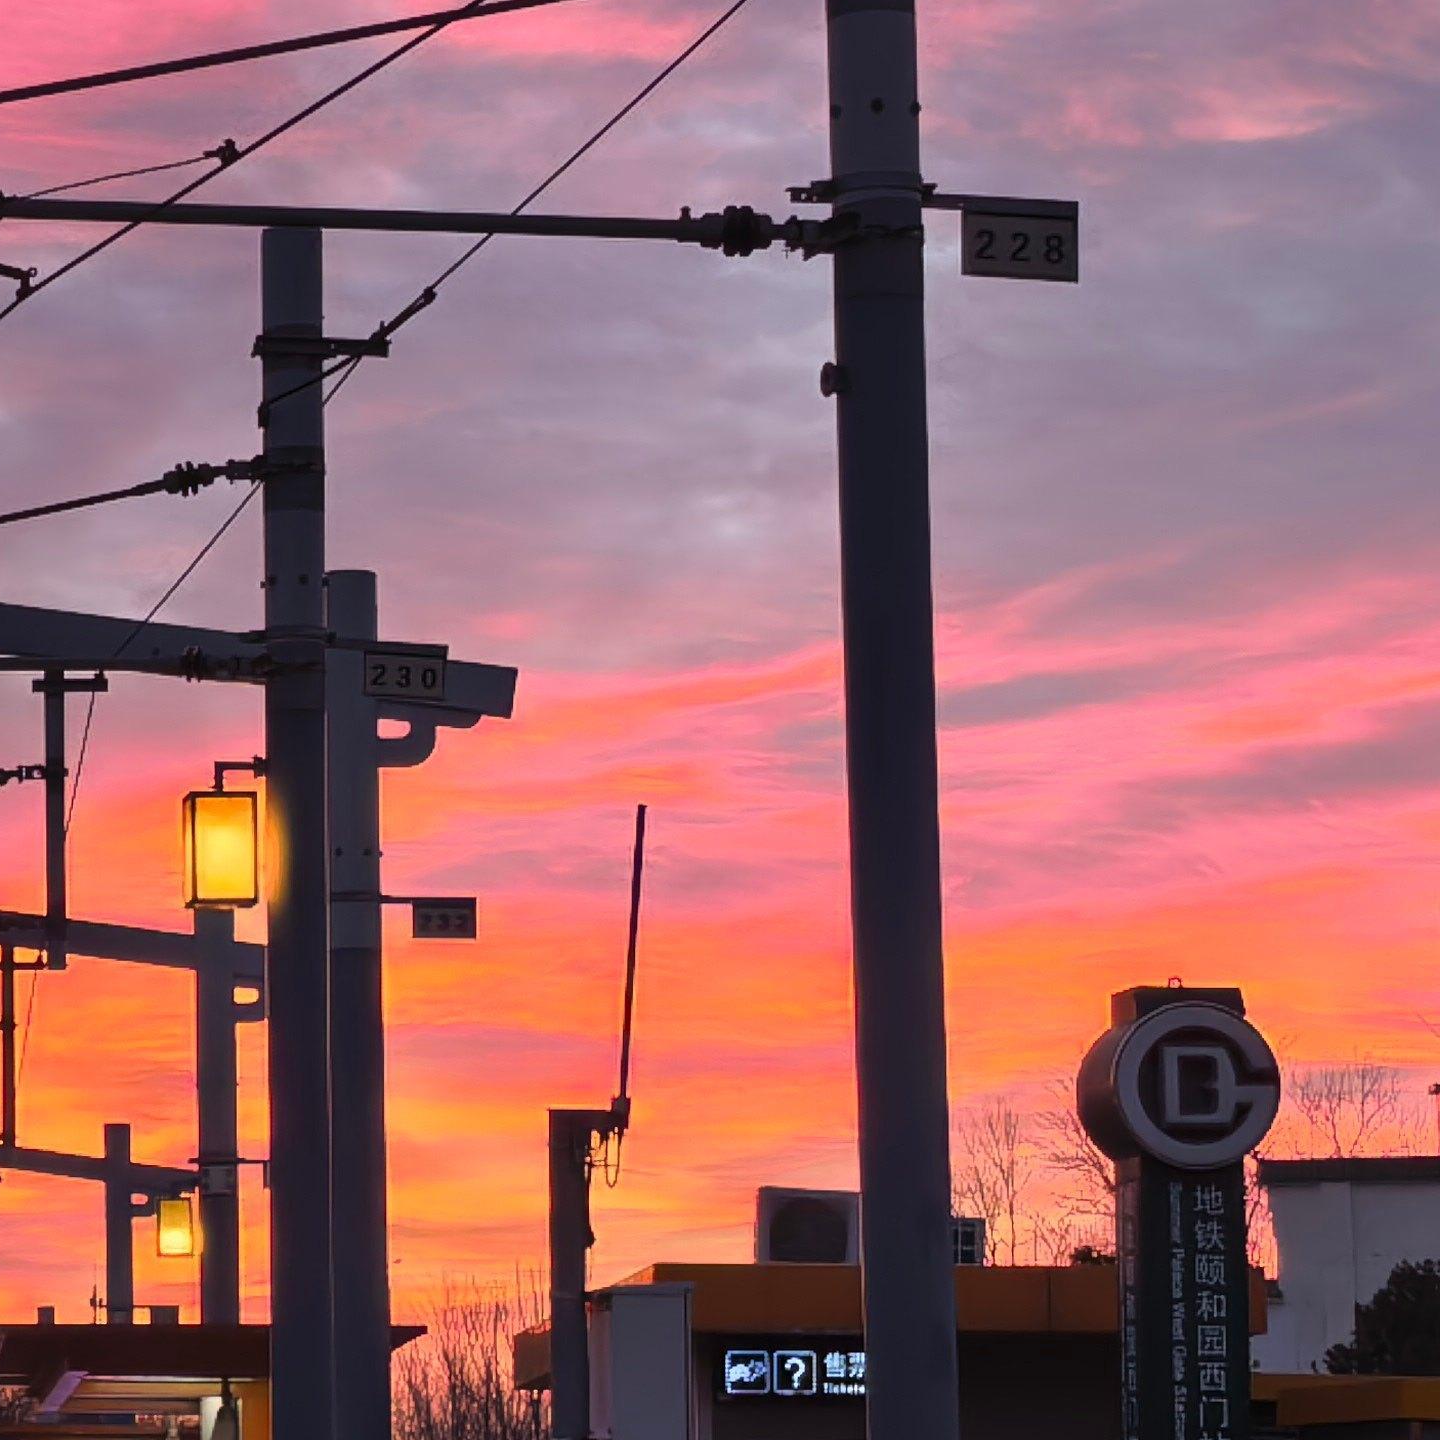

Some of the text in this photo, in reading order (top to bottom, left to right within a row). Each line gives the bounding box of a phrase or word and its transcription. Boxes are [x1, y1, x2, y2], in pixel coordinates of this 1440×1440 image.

[974, 229, 1066, 265] 228
[369, 663, 438, 691] 230
[823, 1350, 866, 1378] 售票
